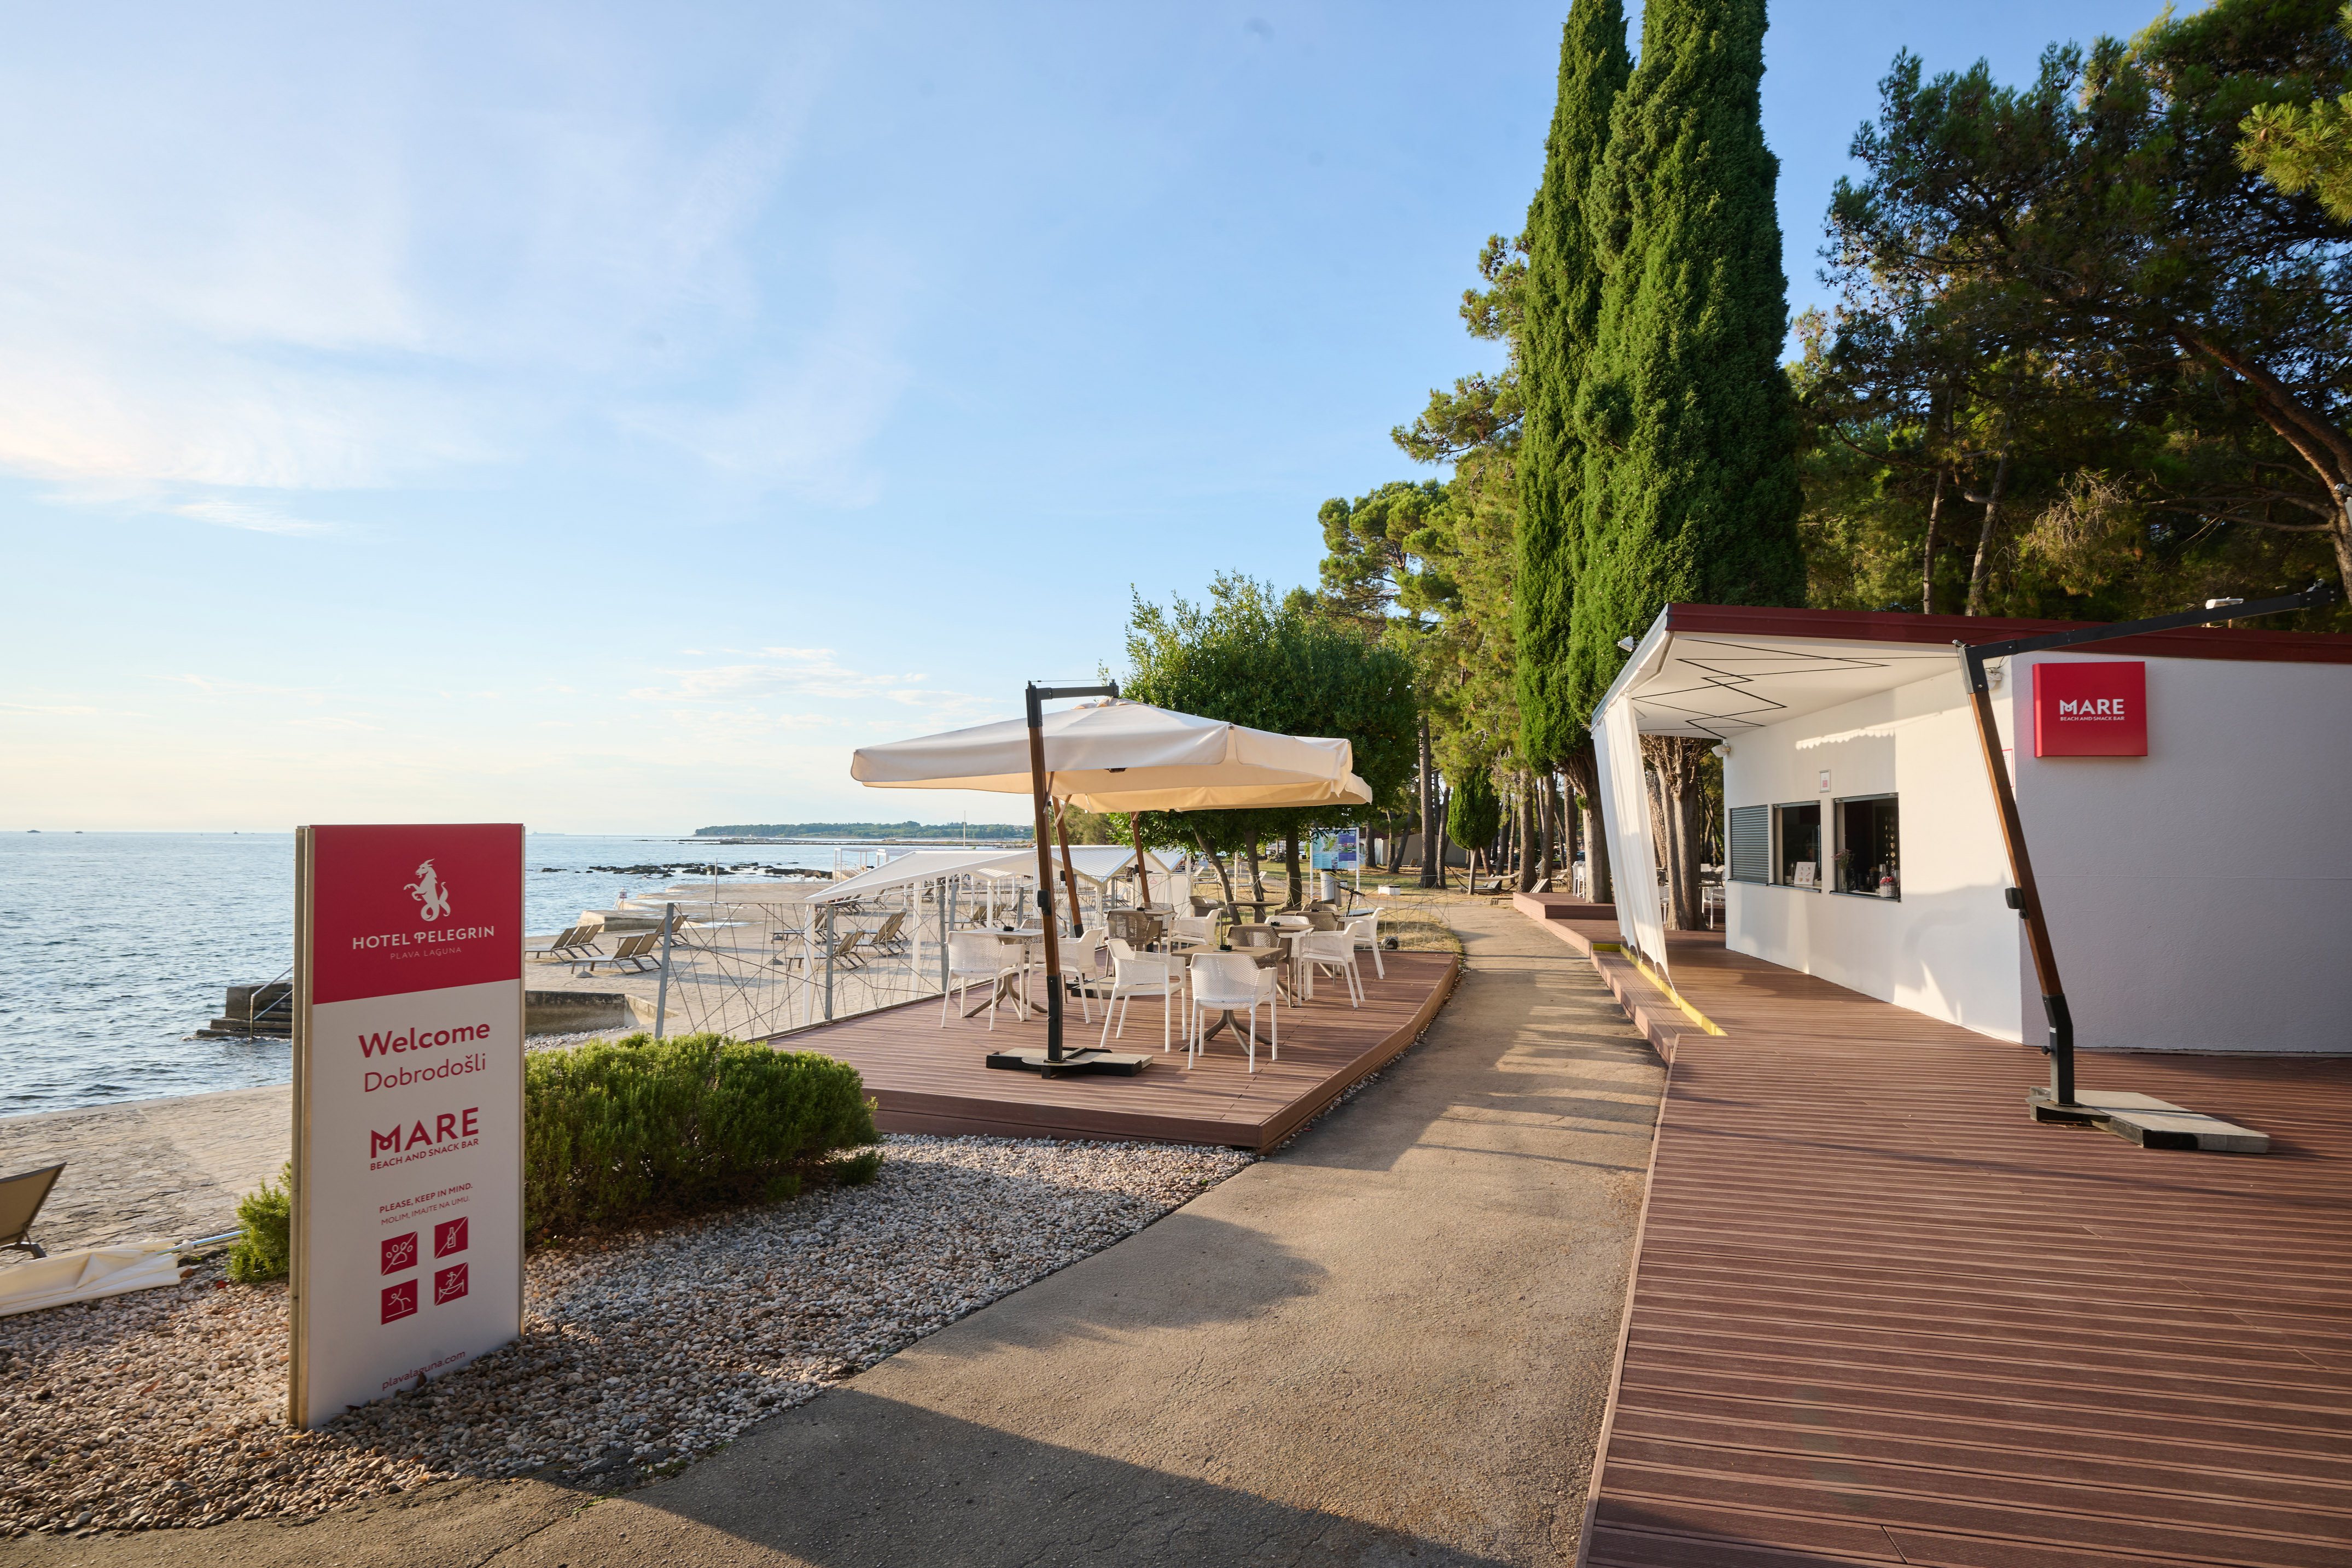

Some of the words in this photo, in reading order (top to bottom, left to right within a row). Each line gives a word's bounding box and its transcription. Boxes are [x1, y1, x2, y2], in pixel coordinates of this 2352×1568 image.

[2059, 699, 2125, 715] MARE
[353, 934, 410, 949] HOTEL
[414, 926, 494, 943] PELEGRIN
[390, 951, 420, 960] PLAVA
[424, 947, 462, 957] LAGUNA
[358, 1024, 490, 1058] Welcome
[364, 1053, 486, 1092] Dobrodošli
[370, 1107, 479, 1159] MARE
[370, 1156, 403, 1171] BEACH
[405, 1151, 427, 1163] AND
[428, 1143, 459, 1157] SNACK
[461, 1138, 479, 1149] BAR
[379, 1198, 414, 1214] PLEASE,
[415, 1192, 435, 1204] KEEP
[437, 1189, 446, 1198] IN
[449, 1183, 473, 1194] MIND.
[381, 1213, 410, 1226] MOLIM,
[411, 1204, 438, 1217] IMAJTE
[439, 1202, 450, 1210] NA
[451, 1196, 470, 1205] UMU.
